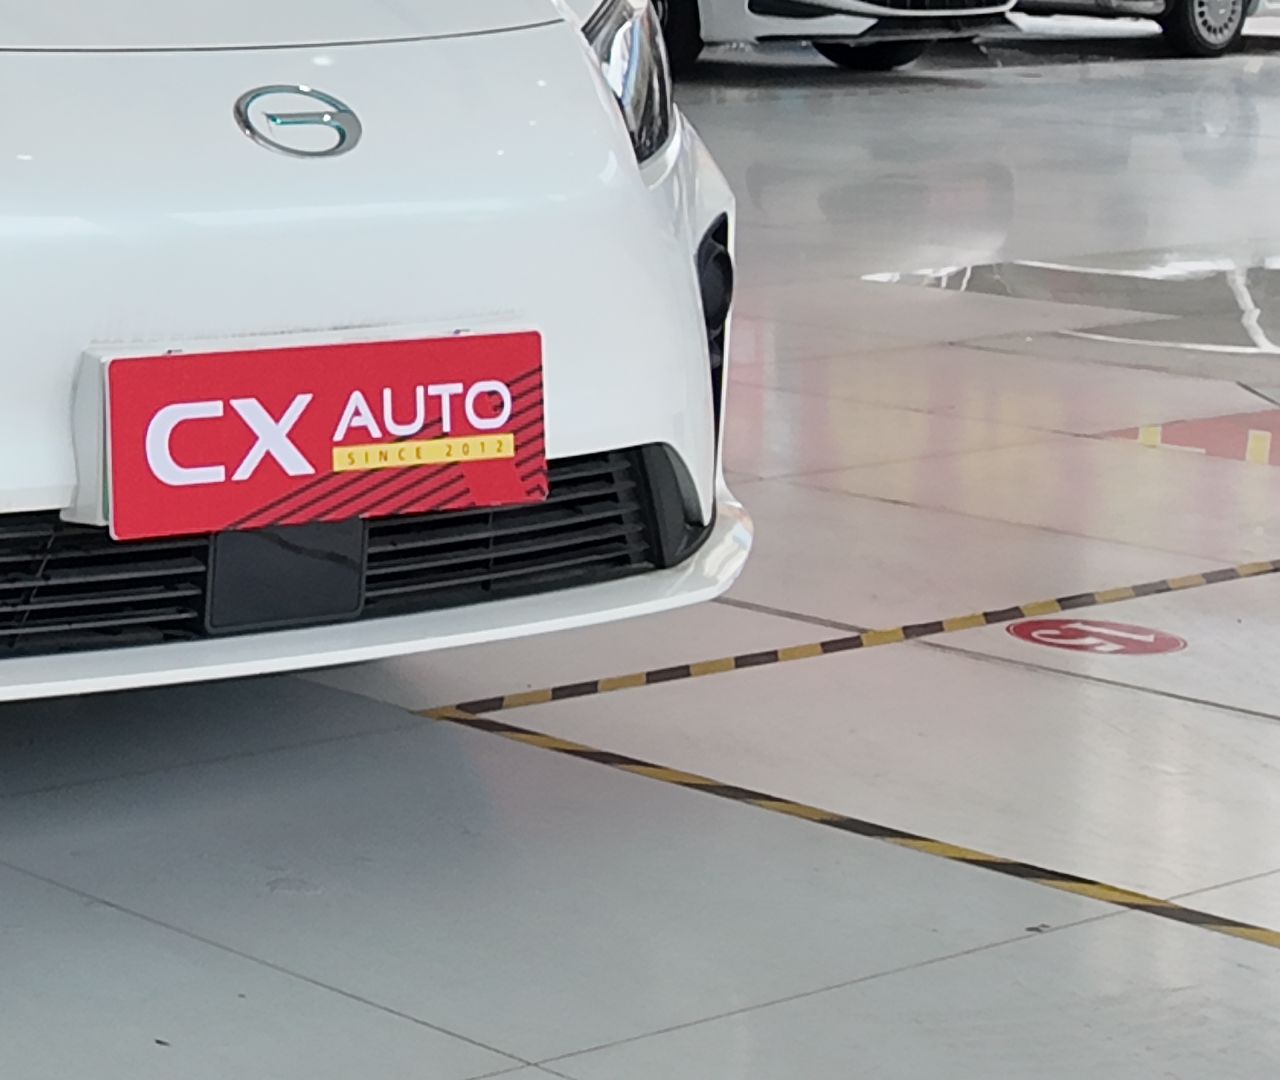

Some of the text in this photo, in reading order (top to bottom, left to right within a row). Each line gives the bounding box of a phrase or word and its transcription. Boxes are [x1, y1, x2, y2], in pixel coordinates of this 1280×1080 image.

[145, 380, 513, 486] CX AUTO
[347, 439, 506, 467] SINCE 2012
